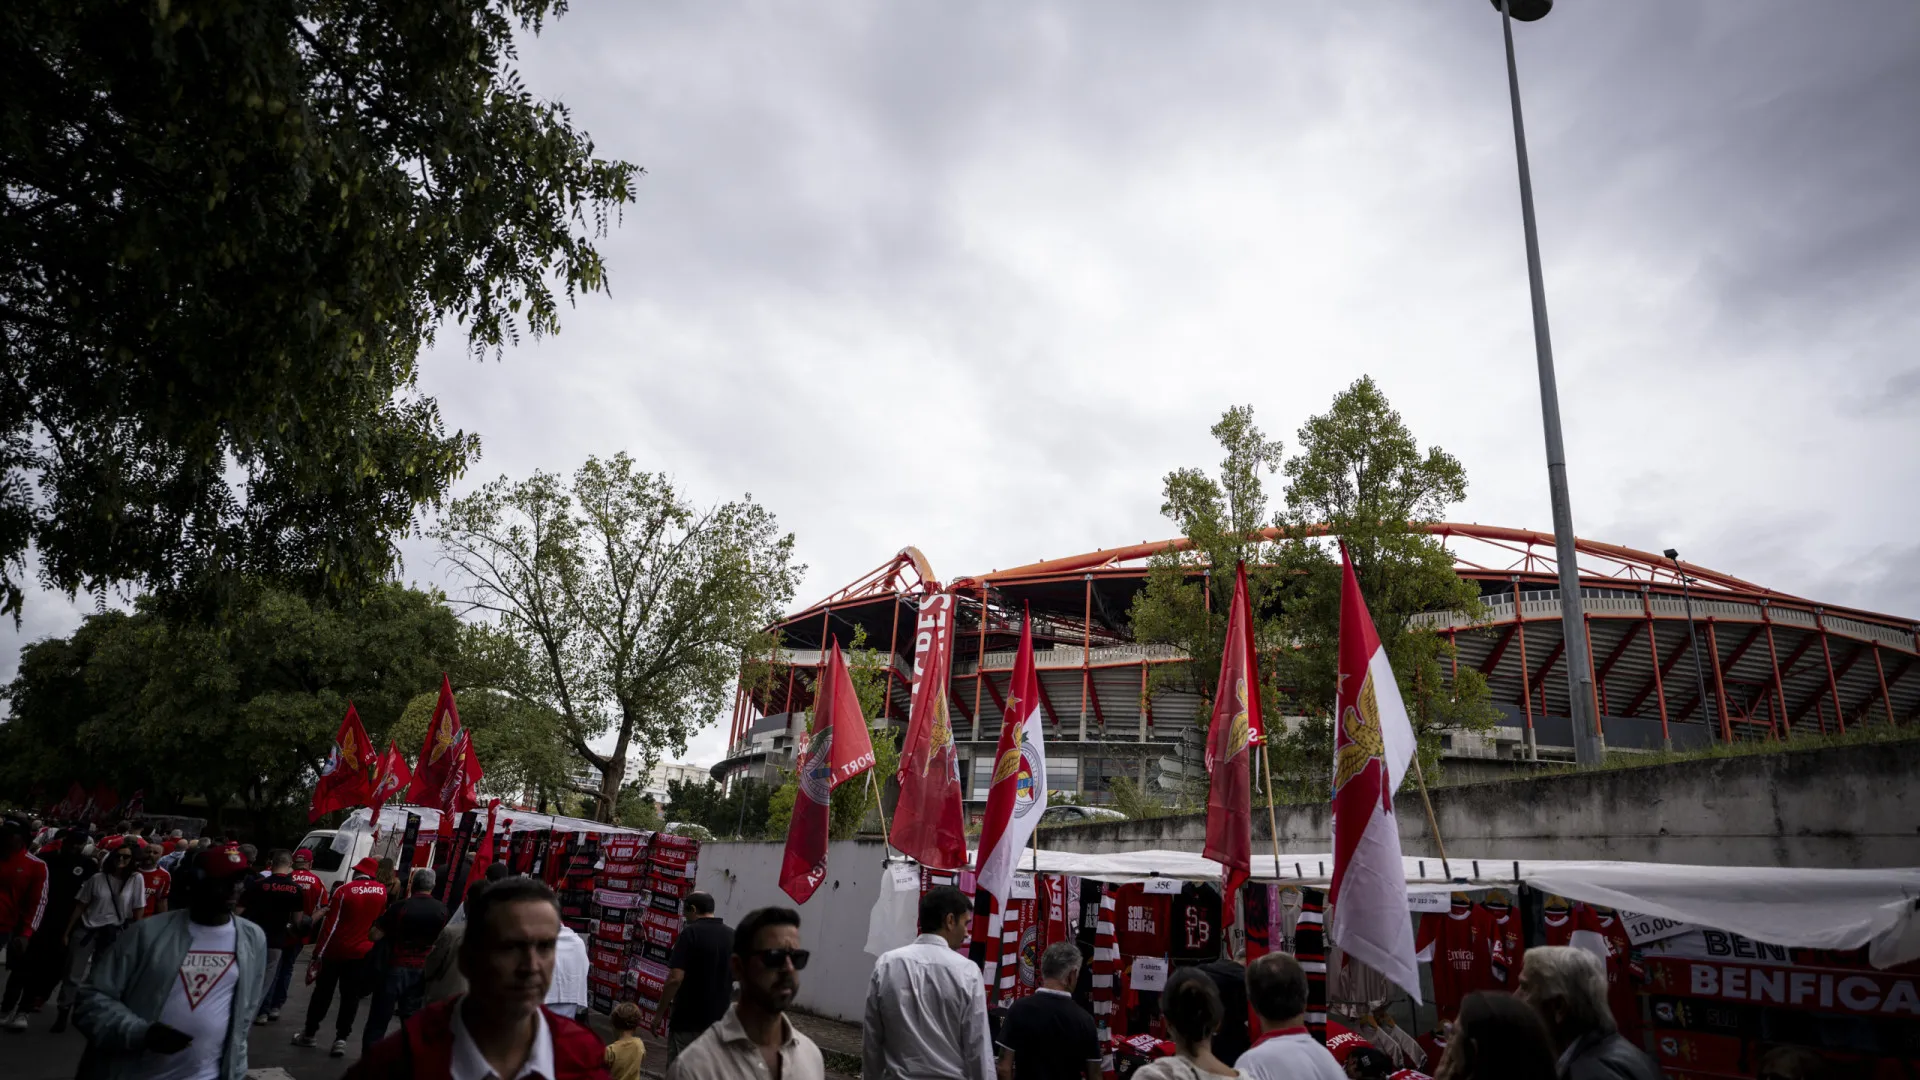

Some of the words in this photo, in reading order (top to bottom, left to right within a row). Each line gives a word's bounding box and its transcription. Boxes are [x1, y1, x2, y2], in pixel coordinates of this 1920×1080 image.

[909, 594, 951, 722] RES
[292, 874, 316, 885] SAGRES
[271, 882, 298, 894] SAGRES
[358, 886, 384, 896] SAGRES
[1128, 905, 1143, 919] SOU
[1128, 918, 1156, 935] BENFICA
[182, 955, 227, 968] GUESS
[1140, 963, 1162, 971] T-shirts
[1690, 964, 1920, 1014] BENFICA
[1326, 1032, 1358, 1049] SAGRES
